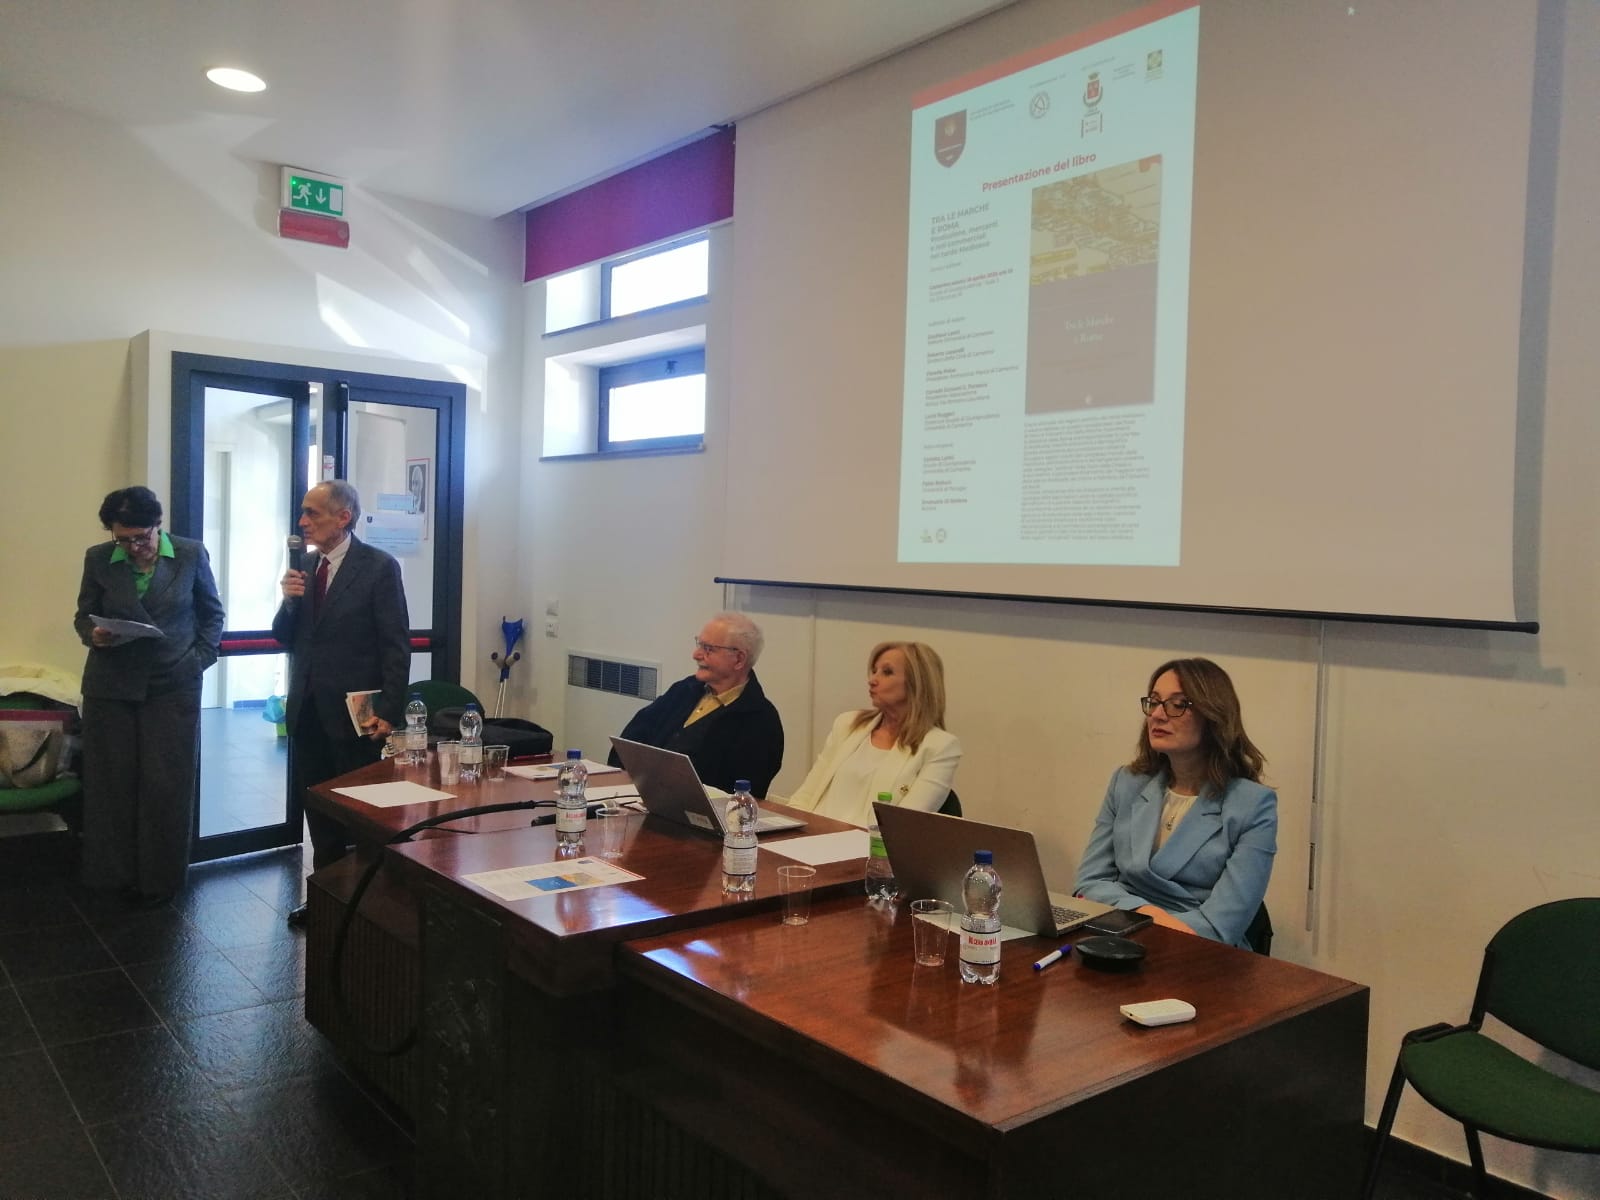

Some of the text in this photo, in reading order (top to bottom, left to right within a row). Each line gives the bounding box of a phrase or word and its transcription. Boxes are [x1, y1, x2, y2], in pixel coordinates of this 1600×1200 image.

[982, 153, 1097, 192] Presentazione del libro
[931, 215, 946, 225] TRA
[957, 202, 990, 218] MARCHE
[937, 220, 960, 233] ROMA
